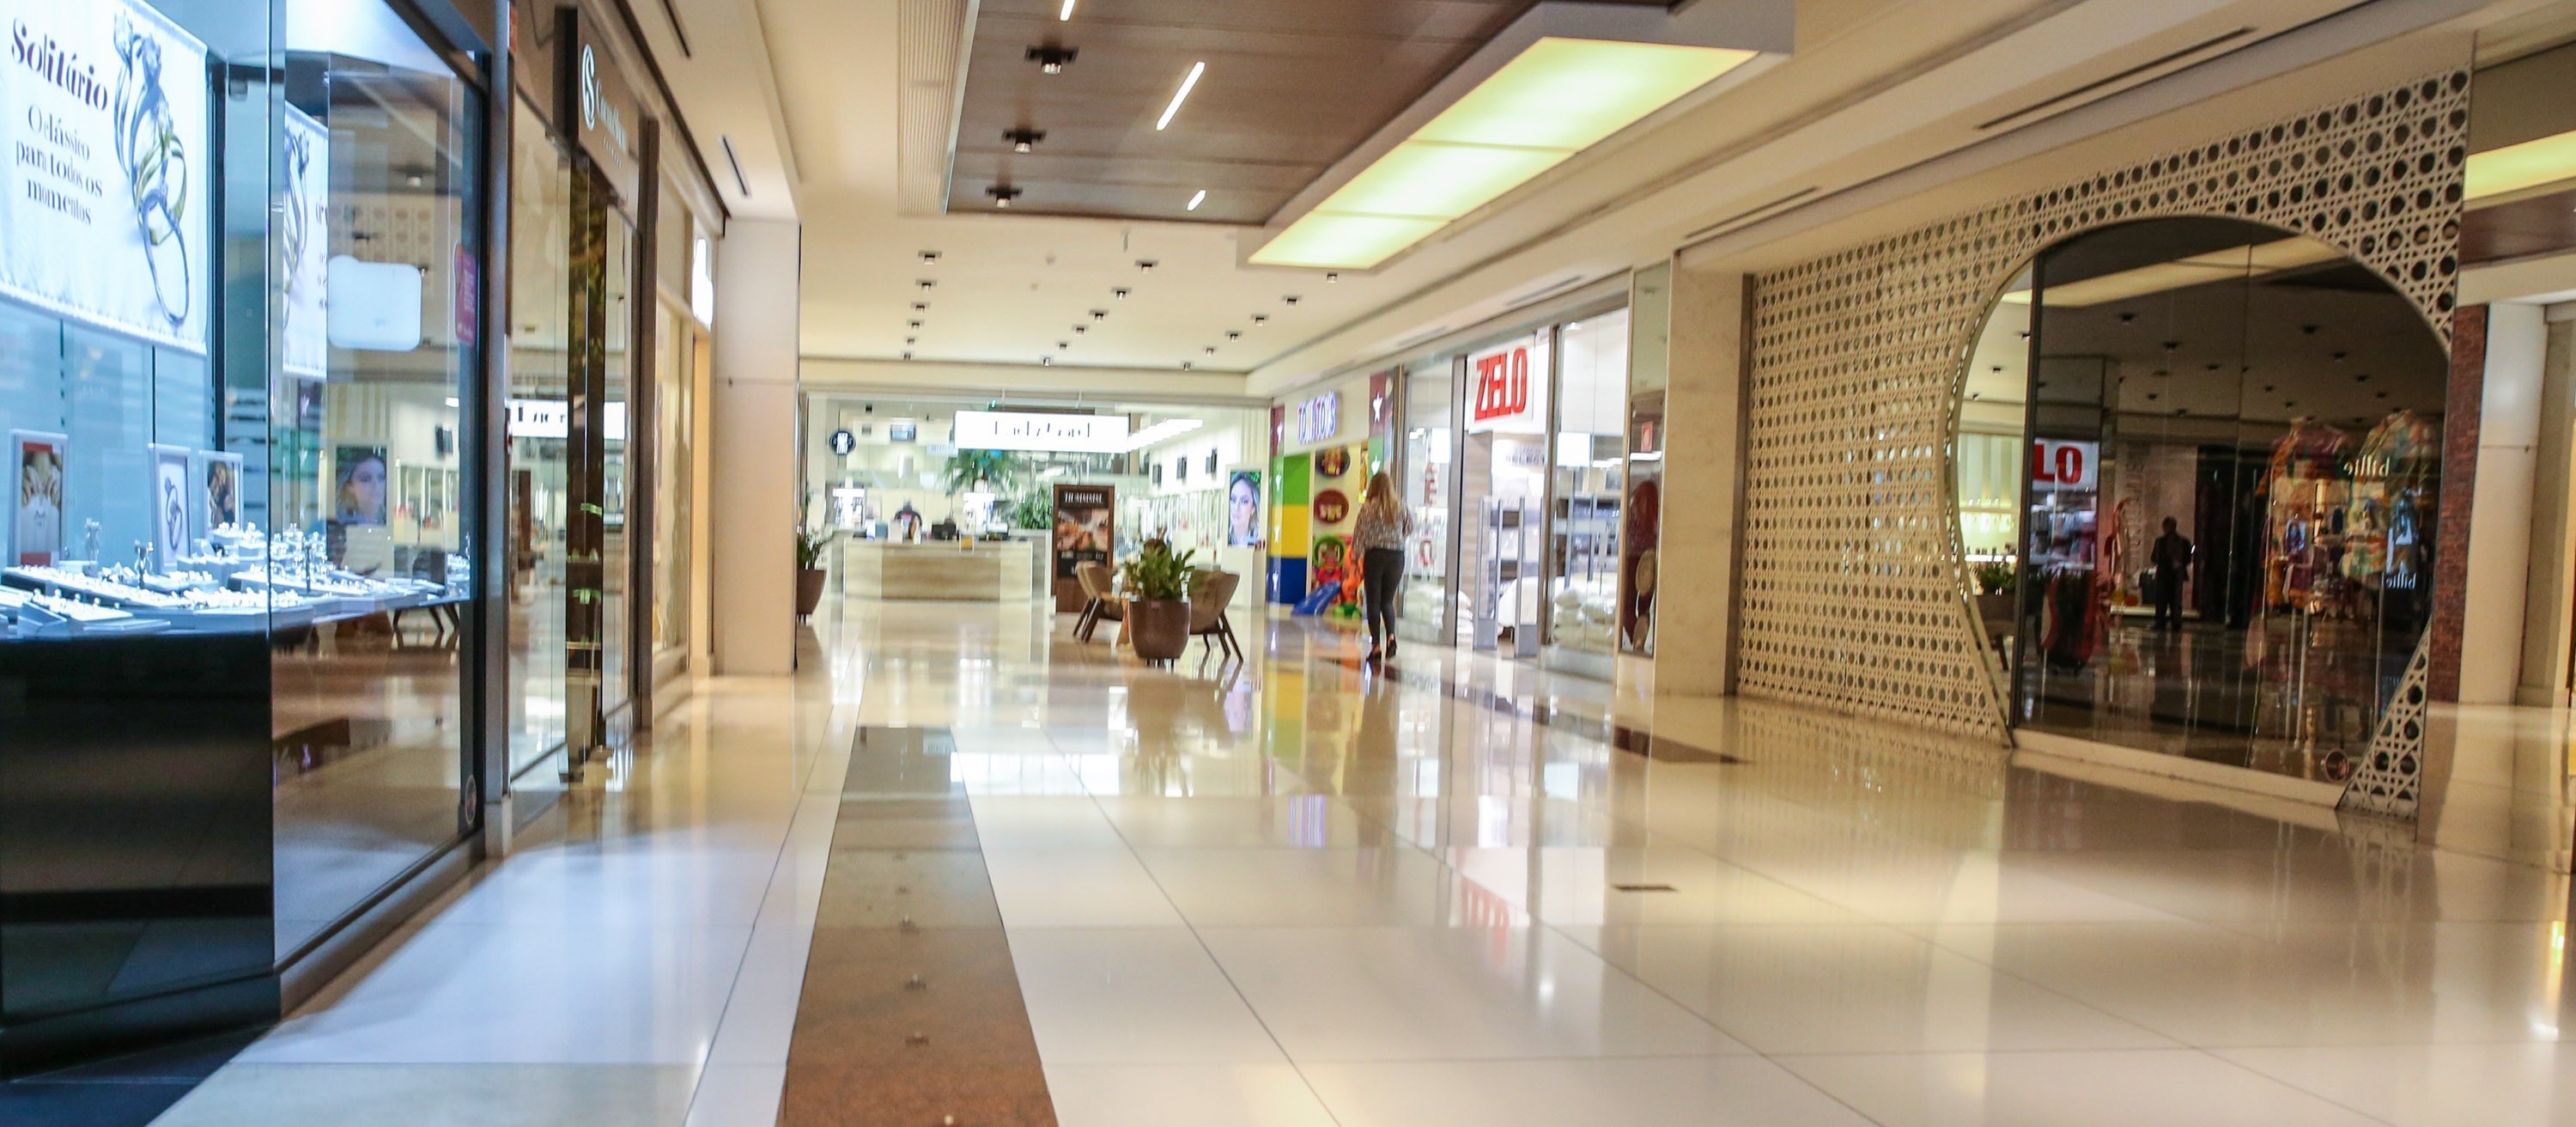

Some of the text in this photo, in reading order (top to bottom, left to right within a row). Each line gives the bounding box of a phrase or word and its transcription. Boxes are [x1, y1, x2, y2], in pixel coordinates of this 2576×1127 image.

[11, 18, 108, 111] Solitário
[28, 104, 42, 133] O
[15, 140, 103, 198] para todos os
[27, 179, 92, 225] momentos
[1474, 347, 1528, 421] ZELO
[2033, 443, 2082, 485] LO
